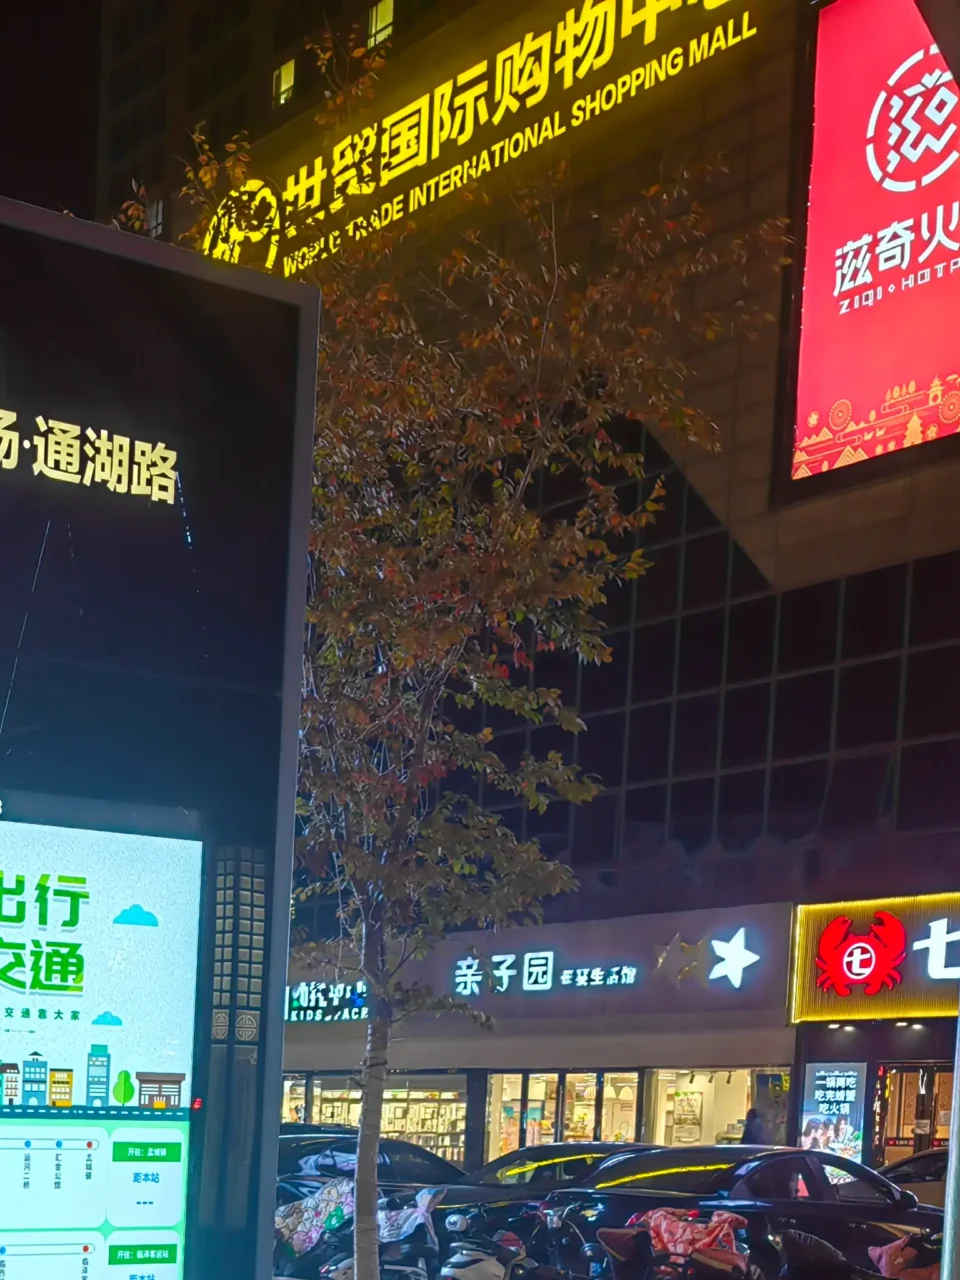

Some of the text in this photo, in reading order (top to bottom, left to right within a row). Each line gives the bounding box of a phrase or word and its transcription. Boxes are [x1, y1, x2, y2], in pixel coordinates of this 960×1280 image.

[408, 111, 566, 213] INTERNATIONAL
[571, 46, 683, 127] SHOPPING
[689, 11, 757, 67] MALL
[455, 951, 554, 995] 亲子园
[132, 1172, 160, 1184] 距本站
